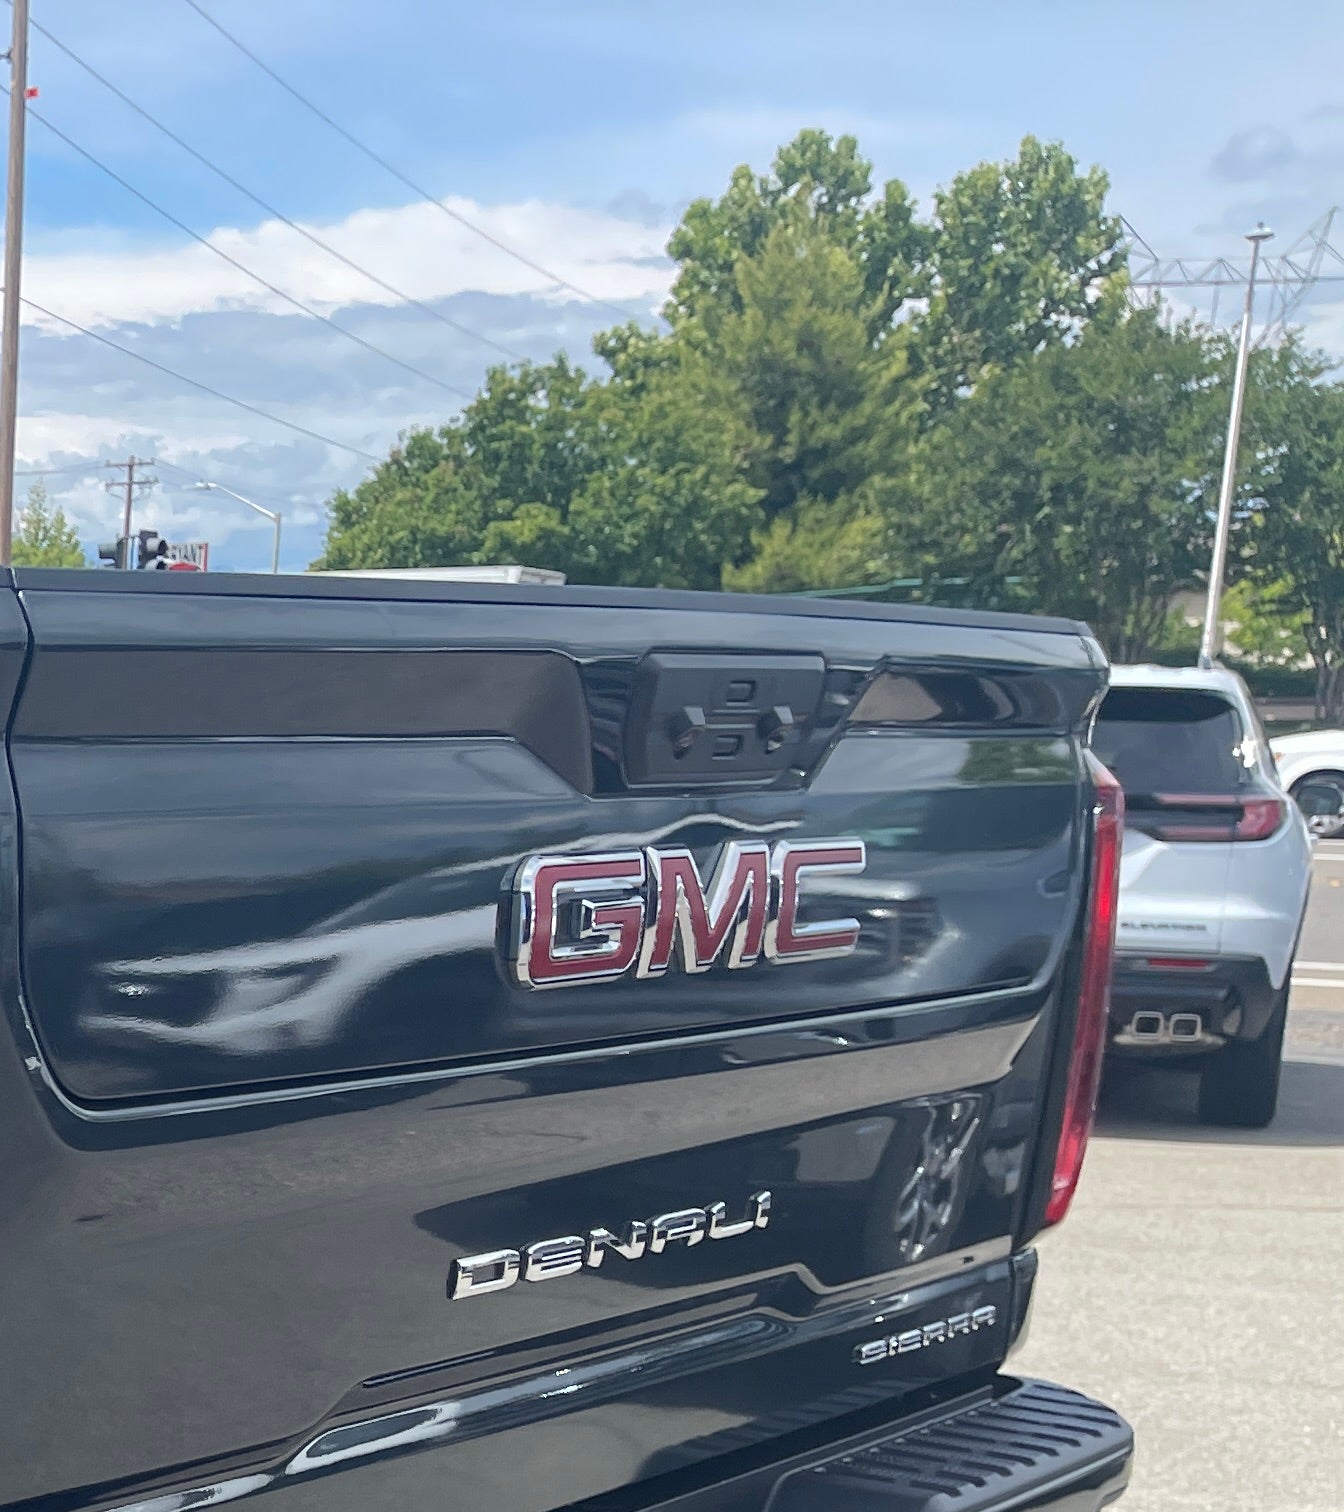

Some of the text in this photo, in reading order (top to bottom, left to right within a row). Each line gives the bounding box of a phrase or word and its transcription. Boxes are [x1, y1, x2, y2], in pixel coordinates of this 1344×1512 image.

[504, 838, 867, 990] GMC
[447, 1190, 772, 1300] DENALI
[854, 1305, 997, 1365] SIERRA
